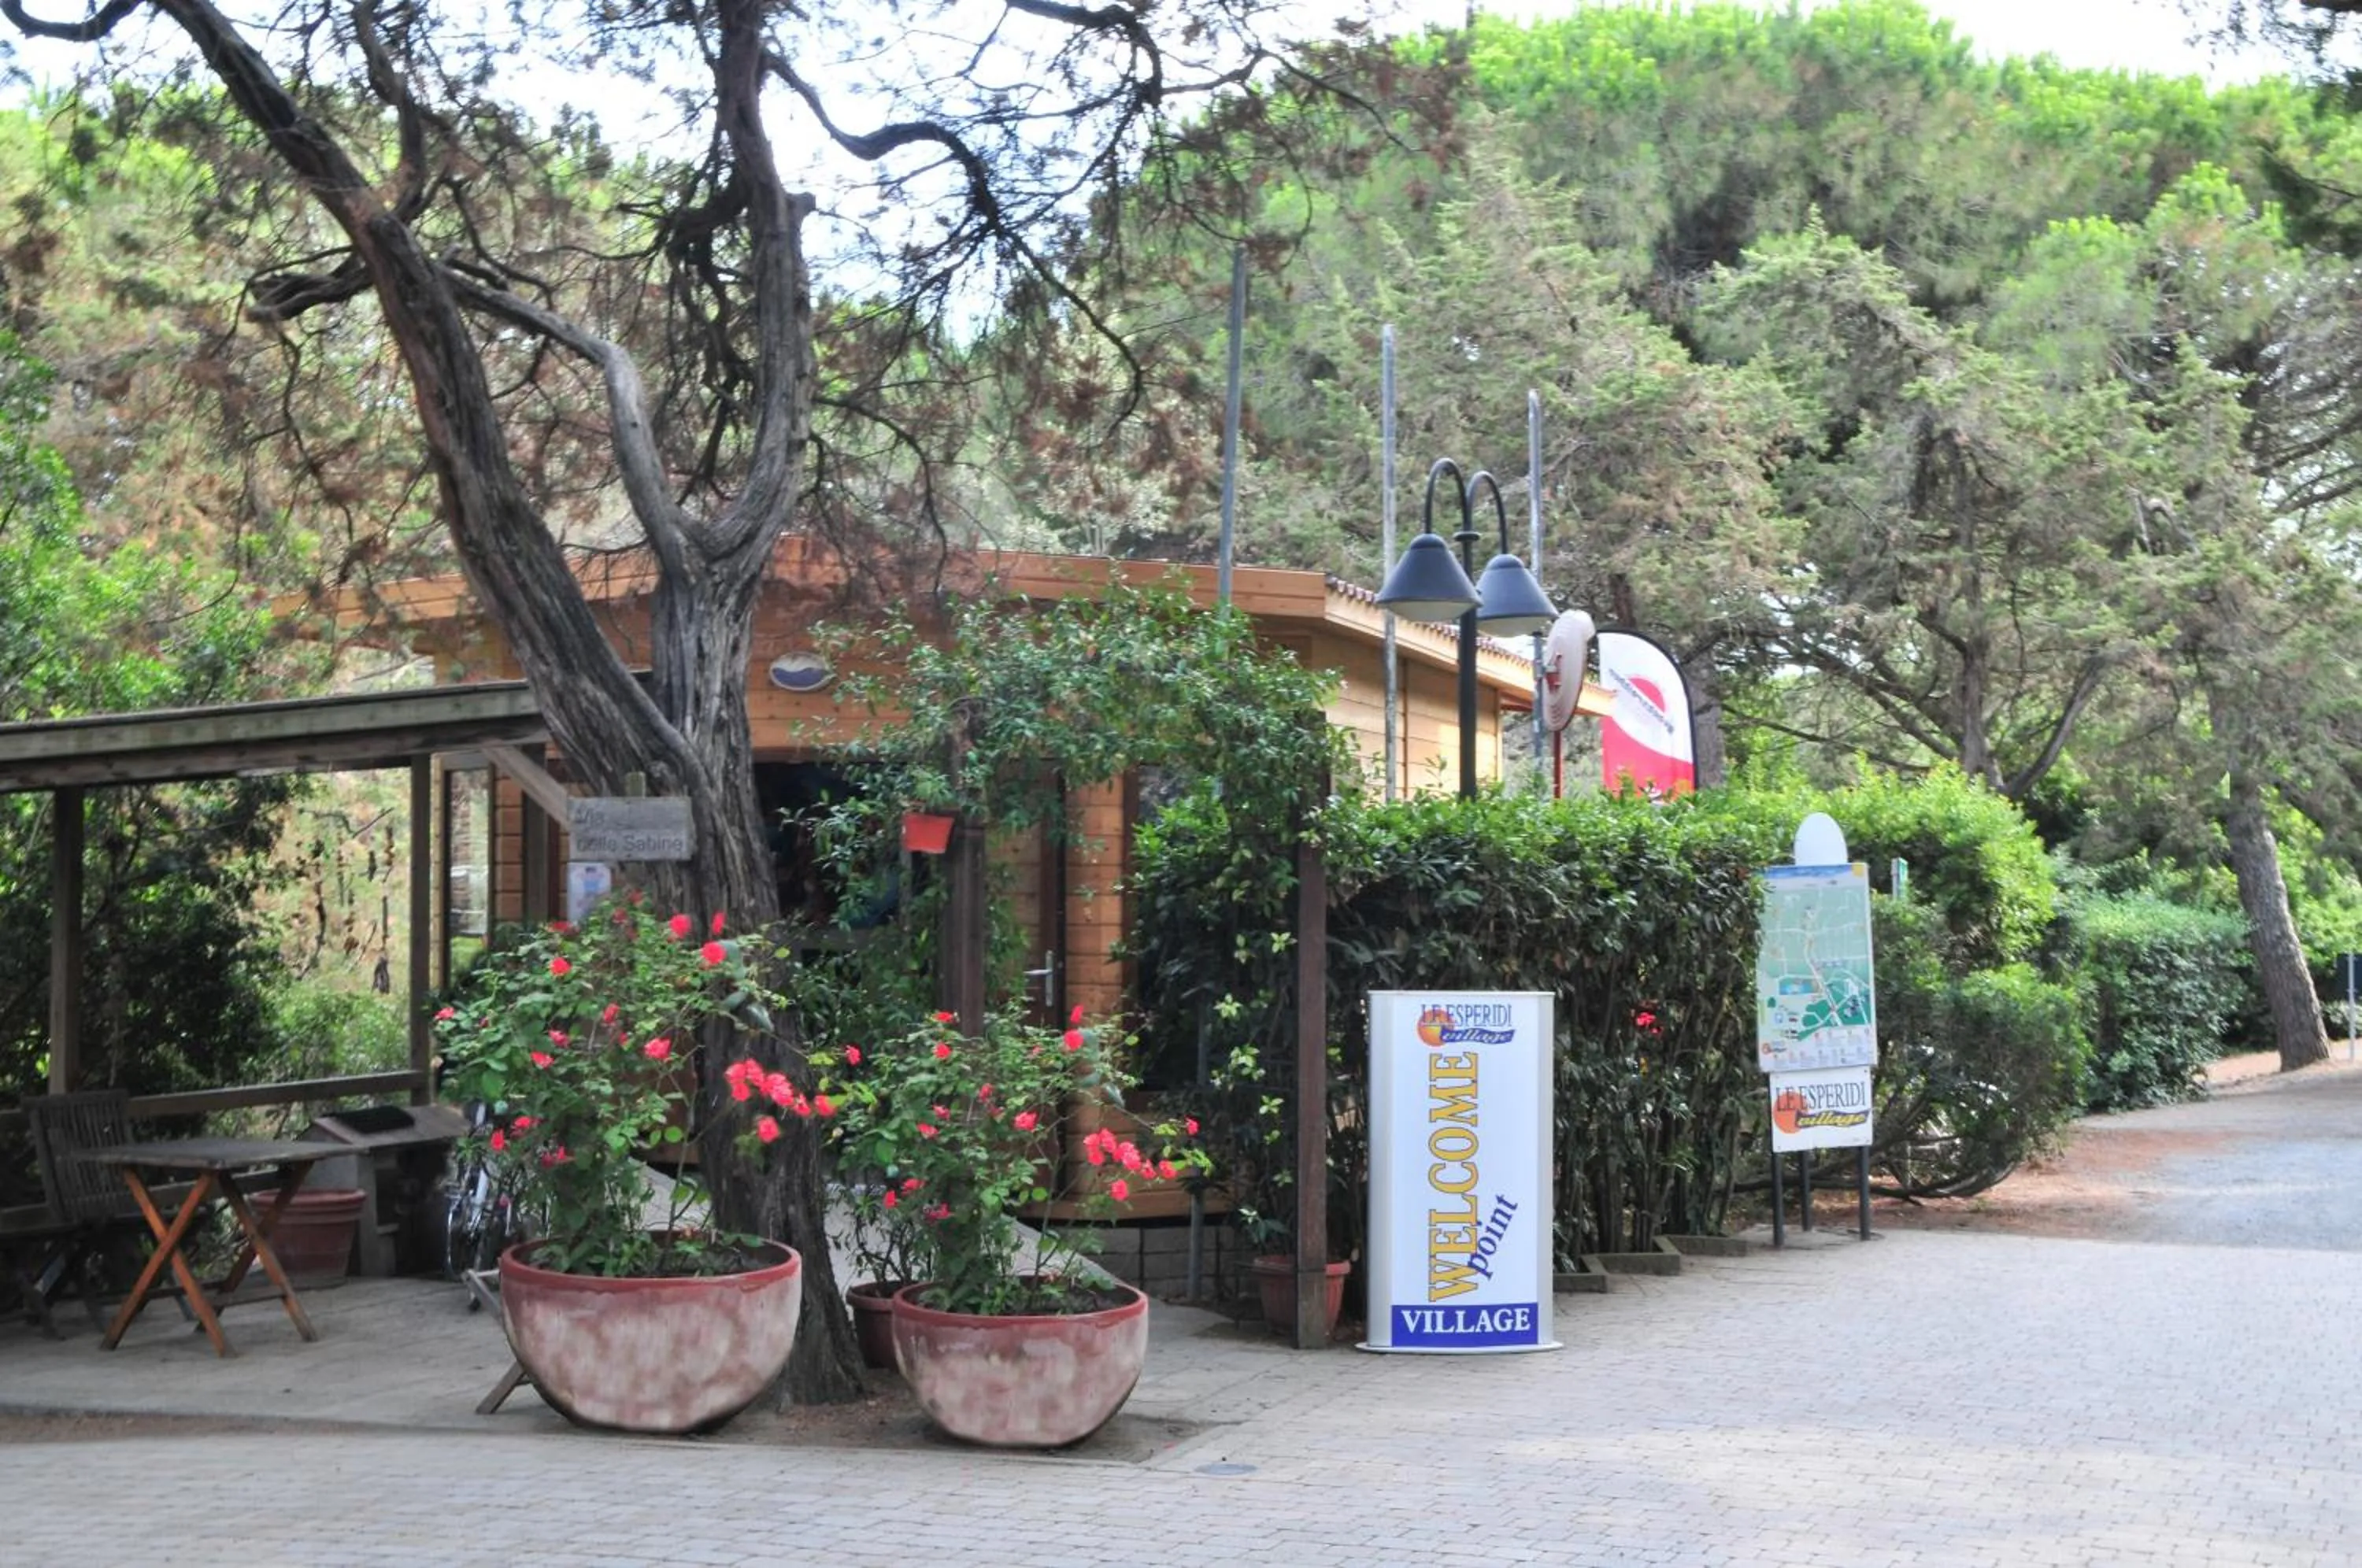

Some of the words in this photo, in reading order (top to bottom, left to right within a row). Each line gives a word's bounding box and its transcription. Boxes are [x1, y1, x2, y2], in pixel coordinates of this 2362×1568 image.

[623, 833, 683, 852] Sabine
[1420, 1004, 1444, 1026] LE
[1446, 1004, 1512, 1026] ESPERIDI
[1443, 1027, 1513, 1045] village
[1775, 1086, 1796, 1111] LE
[1798, 1082, 1866, 1111] ESPERIDI
[1797, 1111, 1866, 1126] village
[1428, 1051, 1479, 1302] WELCOME
[1467, 1193, 1518, 1281] point
[1401, 1307, 1531, 1333] VILLAGE
